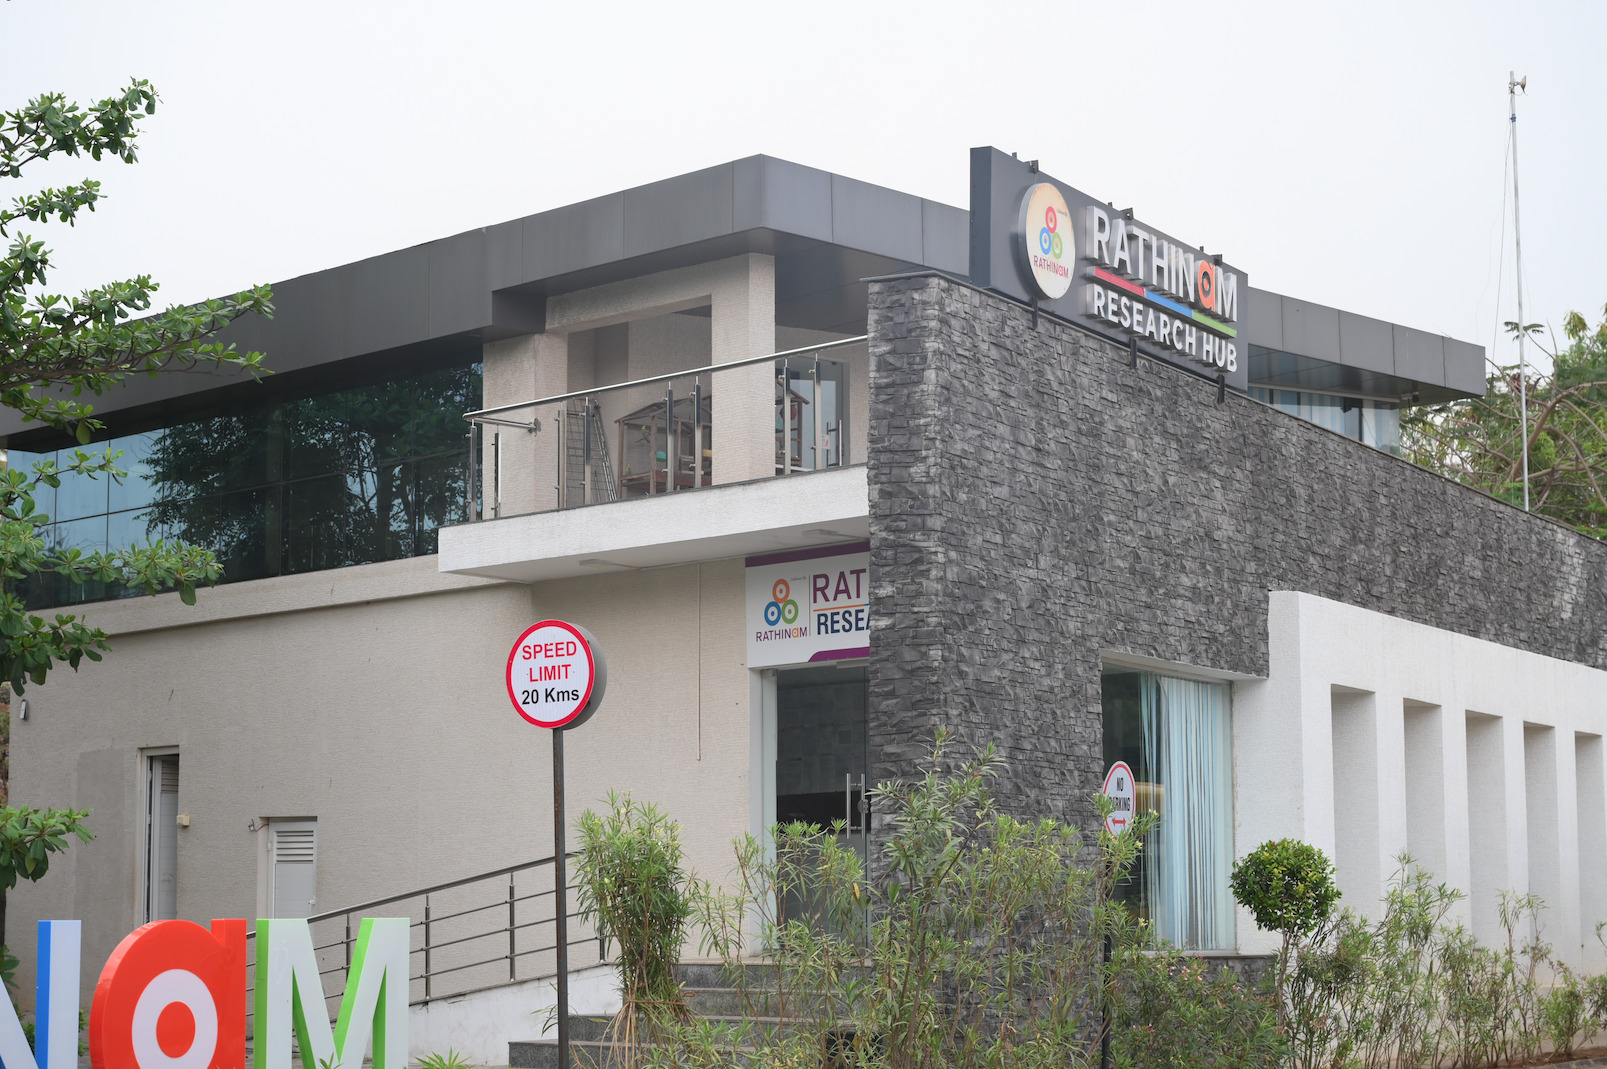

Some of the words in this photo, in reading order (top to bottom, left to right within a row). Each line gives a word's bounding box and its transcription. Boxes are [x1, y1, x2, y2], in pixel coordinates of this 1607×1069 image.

[1088, 283, 1196, 356] RESEARCH
[1203, 332, 1237, 373] HUB
[522, 641, 577, 660] SPEED
[529, 664, 571, 682] LIMIT
[522, 689, 539, 705] 20
[545, 687, 580, 703] Kms
[1116, 777, 1124, 791] NO
[1108, 796, 1131, 811] RKING
